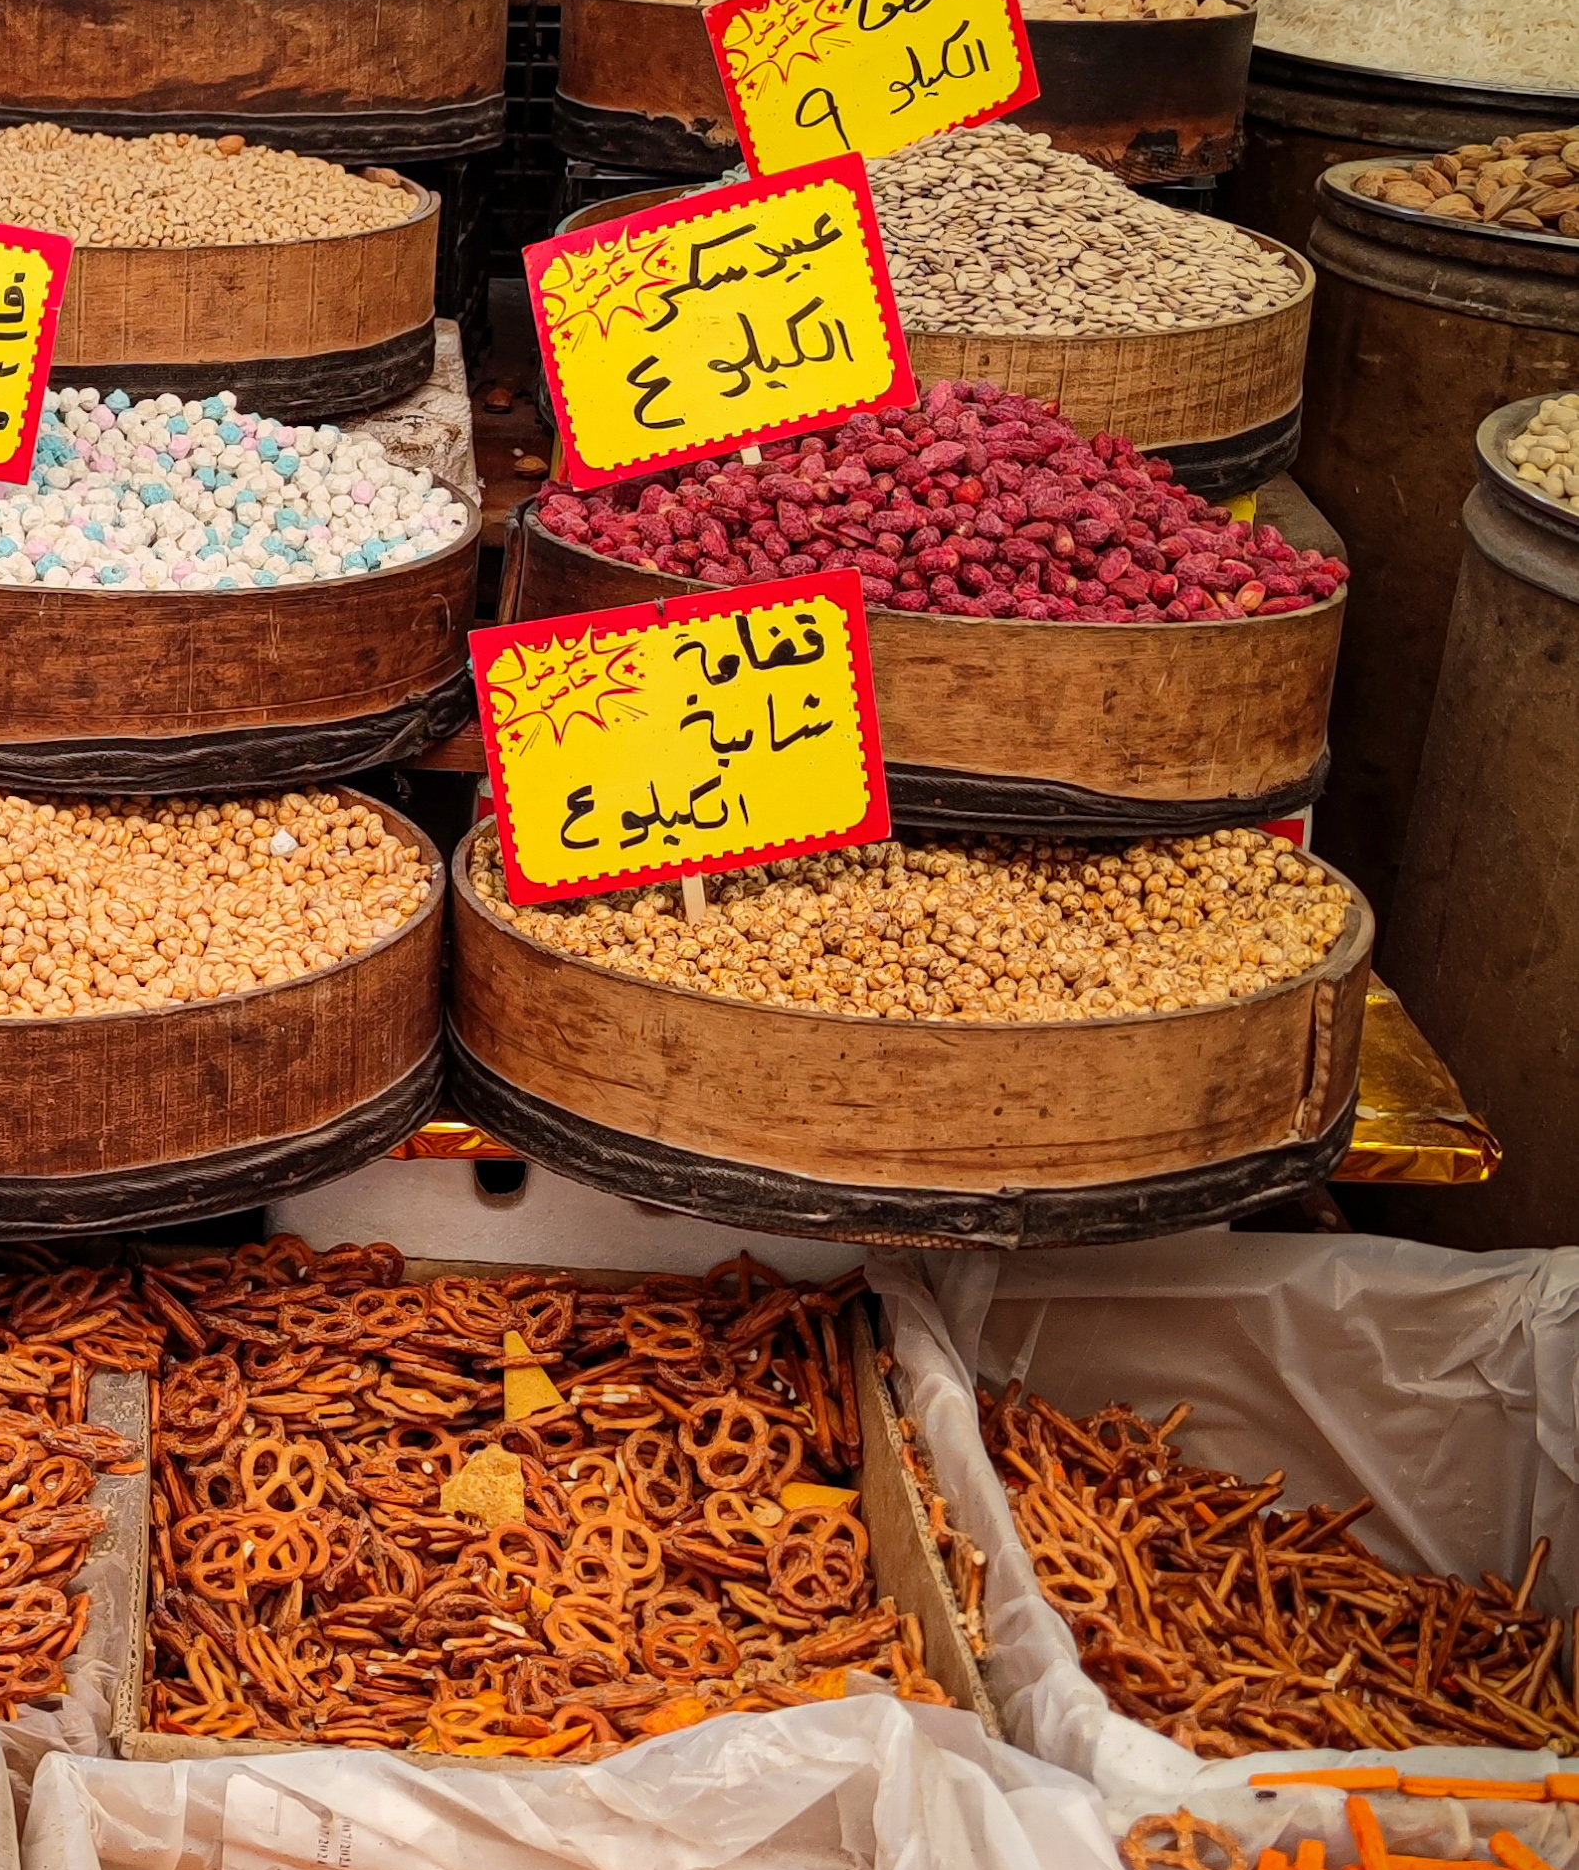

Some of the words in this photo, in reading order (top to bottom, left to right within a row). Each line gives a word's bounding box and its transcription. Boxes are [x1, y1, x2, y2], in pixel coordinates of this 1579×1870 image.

[888, 19, 991, 116] الكيلو
[794, 87, 852, 151] ٩
[707, 296, 856, 399] الكيلو
[625, 355, 686, 430] ٤
[619, 774, 751, 849] الكيلو
